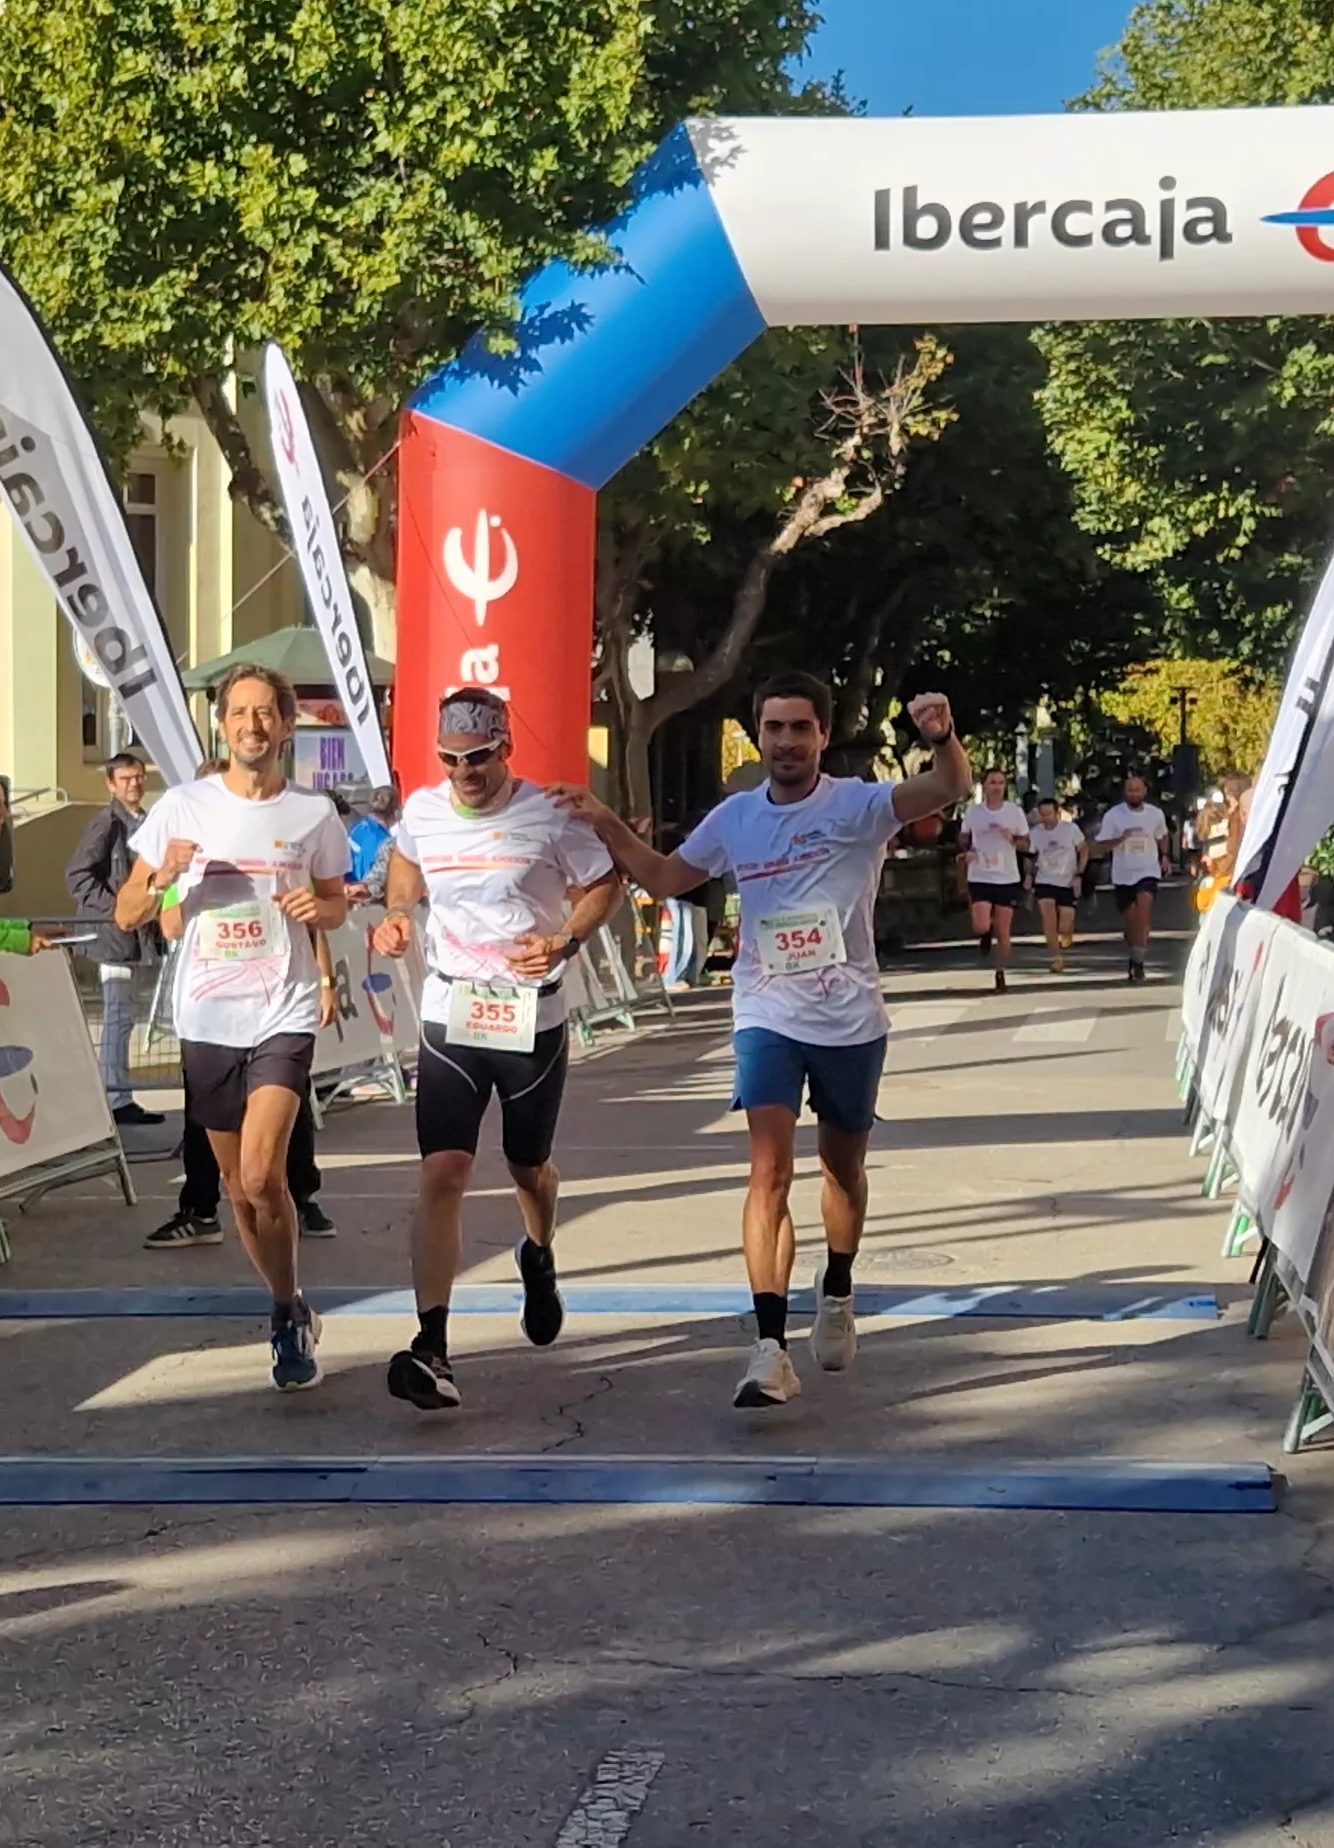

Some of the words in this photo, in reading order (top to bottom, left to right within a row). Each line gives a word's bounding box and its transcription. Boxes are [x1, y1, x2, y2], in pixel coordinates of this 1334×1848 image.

[873, 175, 1233, 261] Ibercaja
[216, 920, 264, 940] 356
[774, 927, 823, 952] 354
[470, 1001, 517, 1023] 355
